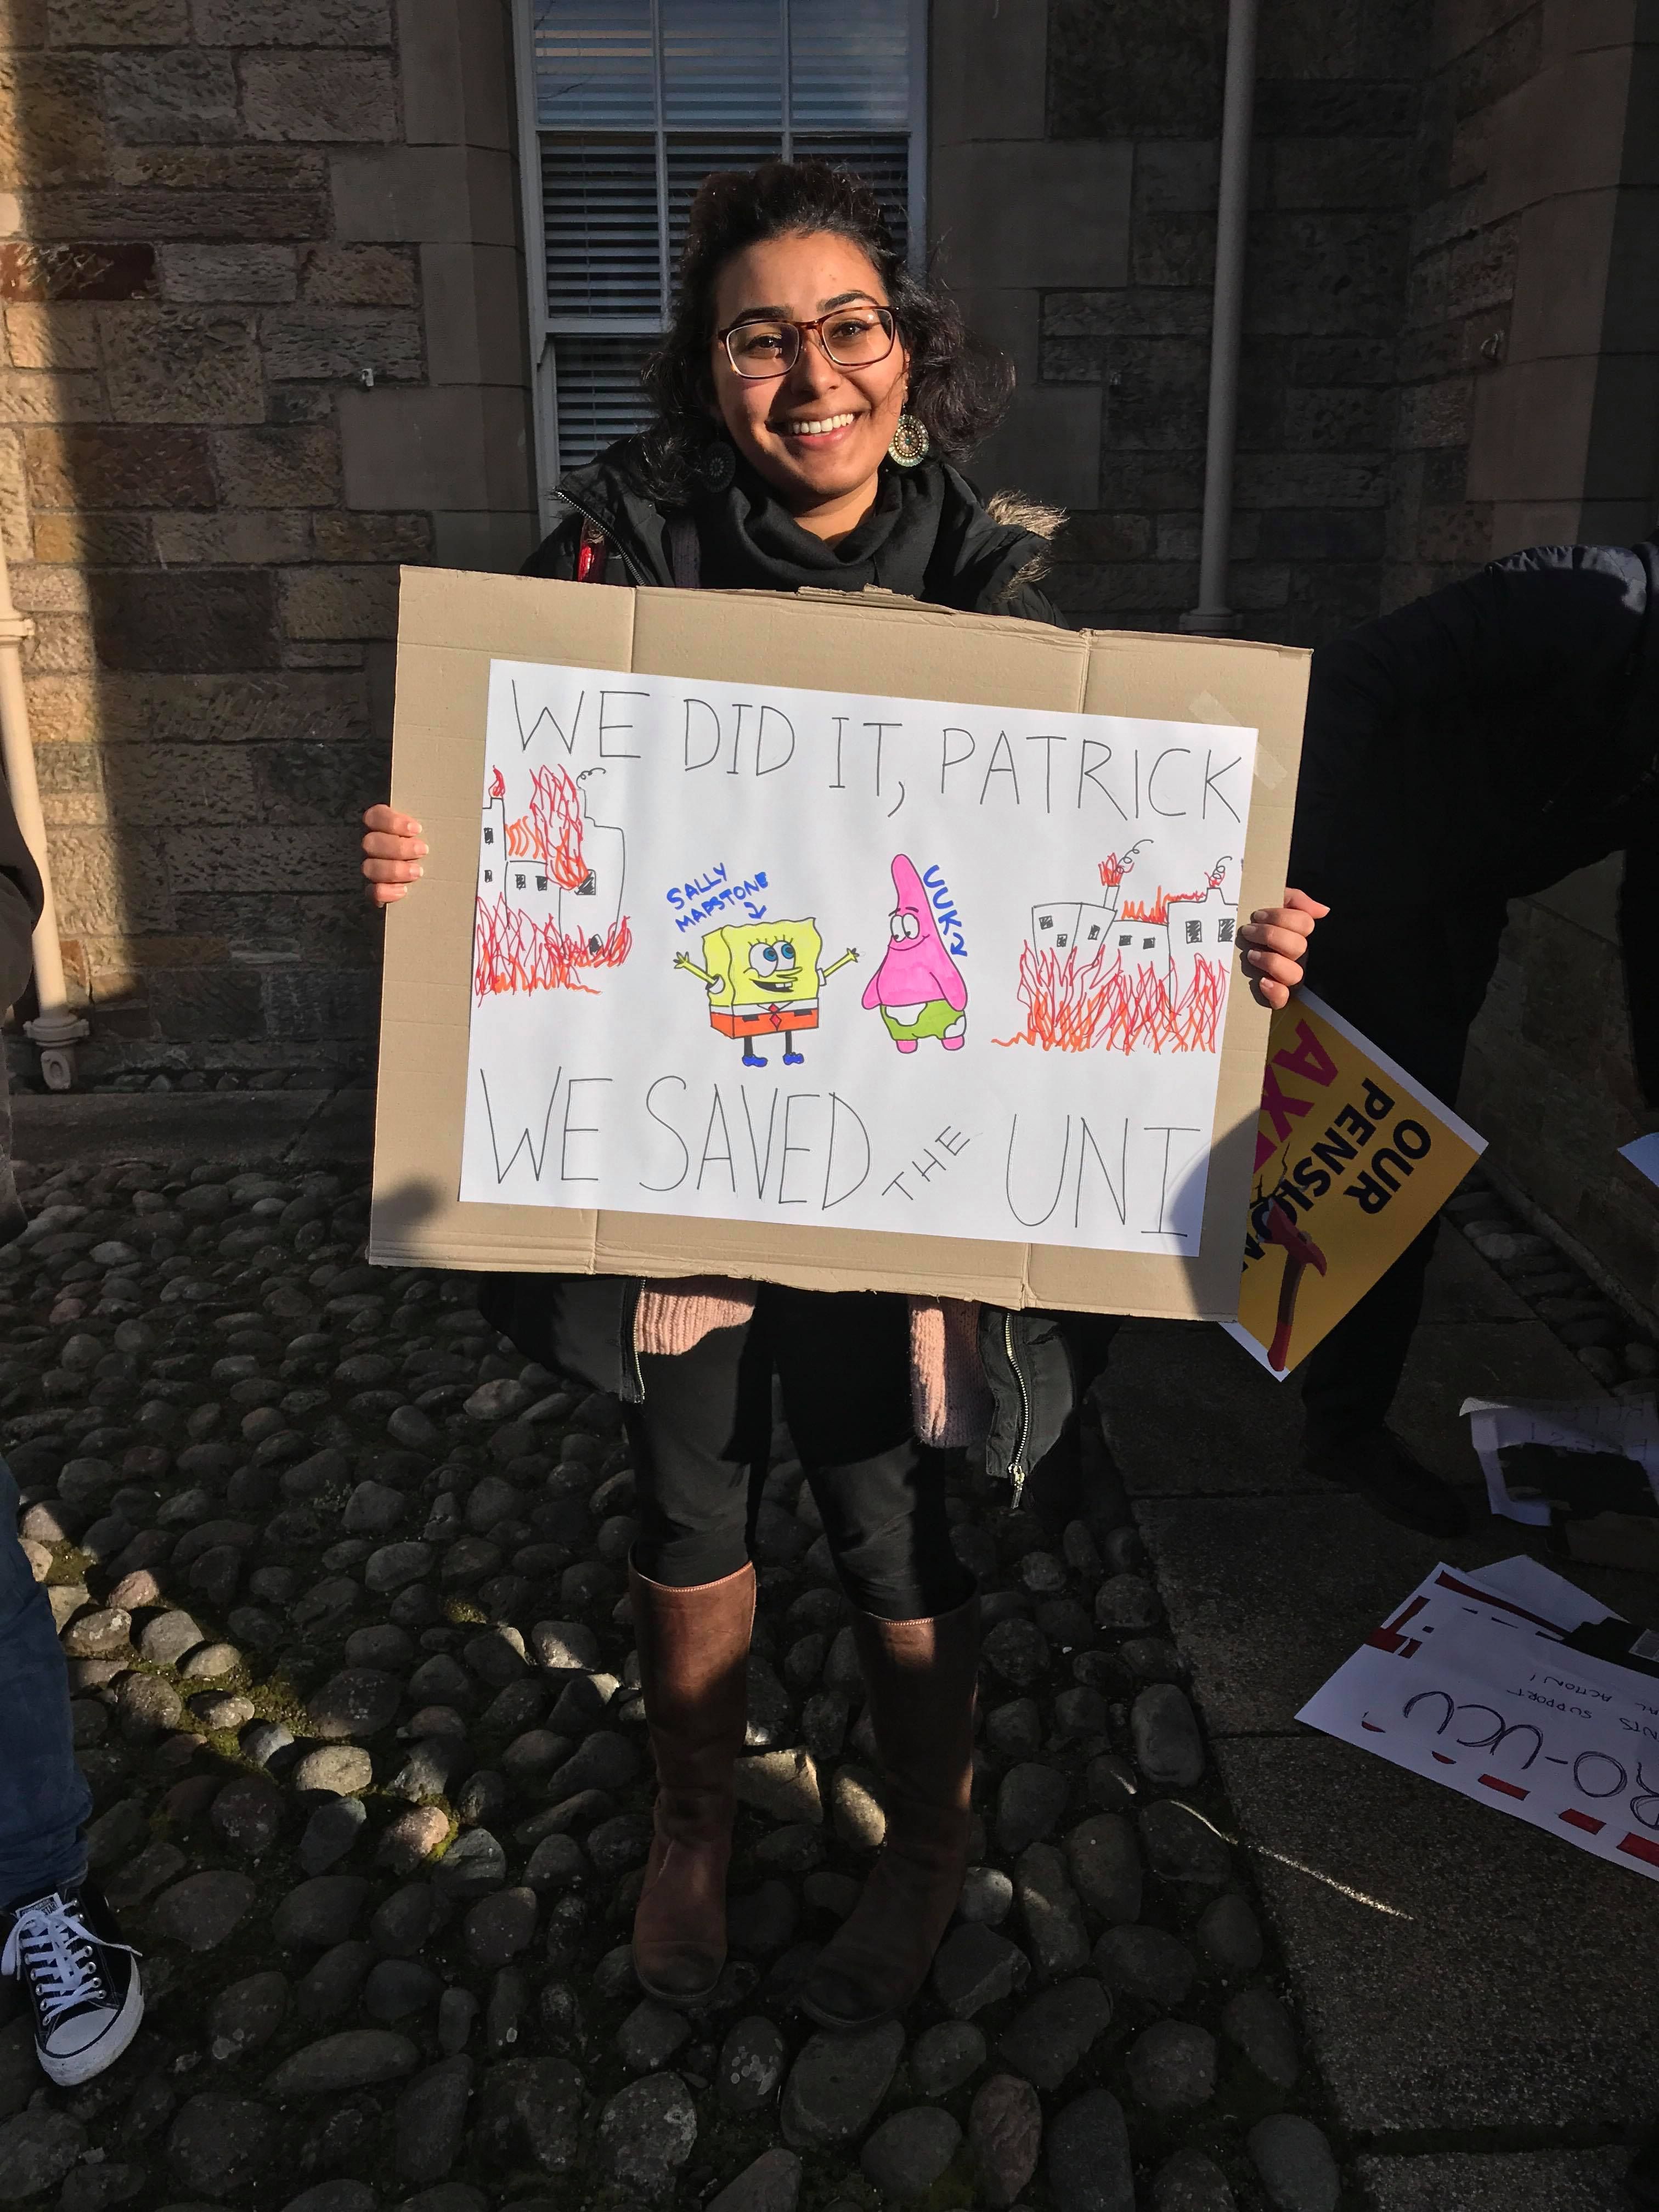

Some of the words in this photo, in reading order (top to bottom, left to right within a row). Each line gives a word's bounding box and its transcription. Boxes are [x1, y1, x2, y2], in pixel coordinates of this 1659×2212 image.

[511, 679, 651, 759] WE
[683, 698, 795, 776] DID
[829, 716, 905, 818] IT,
[941, 727, 1242, 823] PATRICK
[666, 862, 727, 910] SALLY
[675, 871, 769, 933] MAPSTONE
[923, 864, 962, 936] UUK
[1254, 1018, 1339, 1175] AX
[480, 1066, 613, 1184] WE
[639, 1075, 871, 1210] SAVED
[882, 1126, 971, 1201] THE
[1006, 1113, 1202, 1238] UNI
[1343, 1118, 1432, 1215] OUR
[1506, 1688, 1592, 1719] SUPPORT
[1619, 1717, 1659, 1742] NTS
